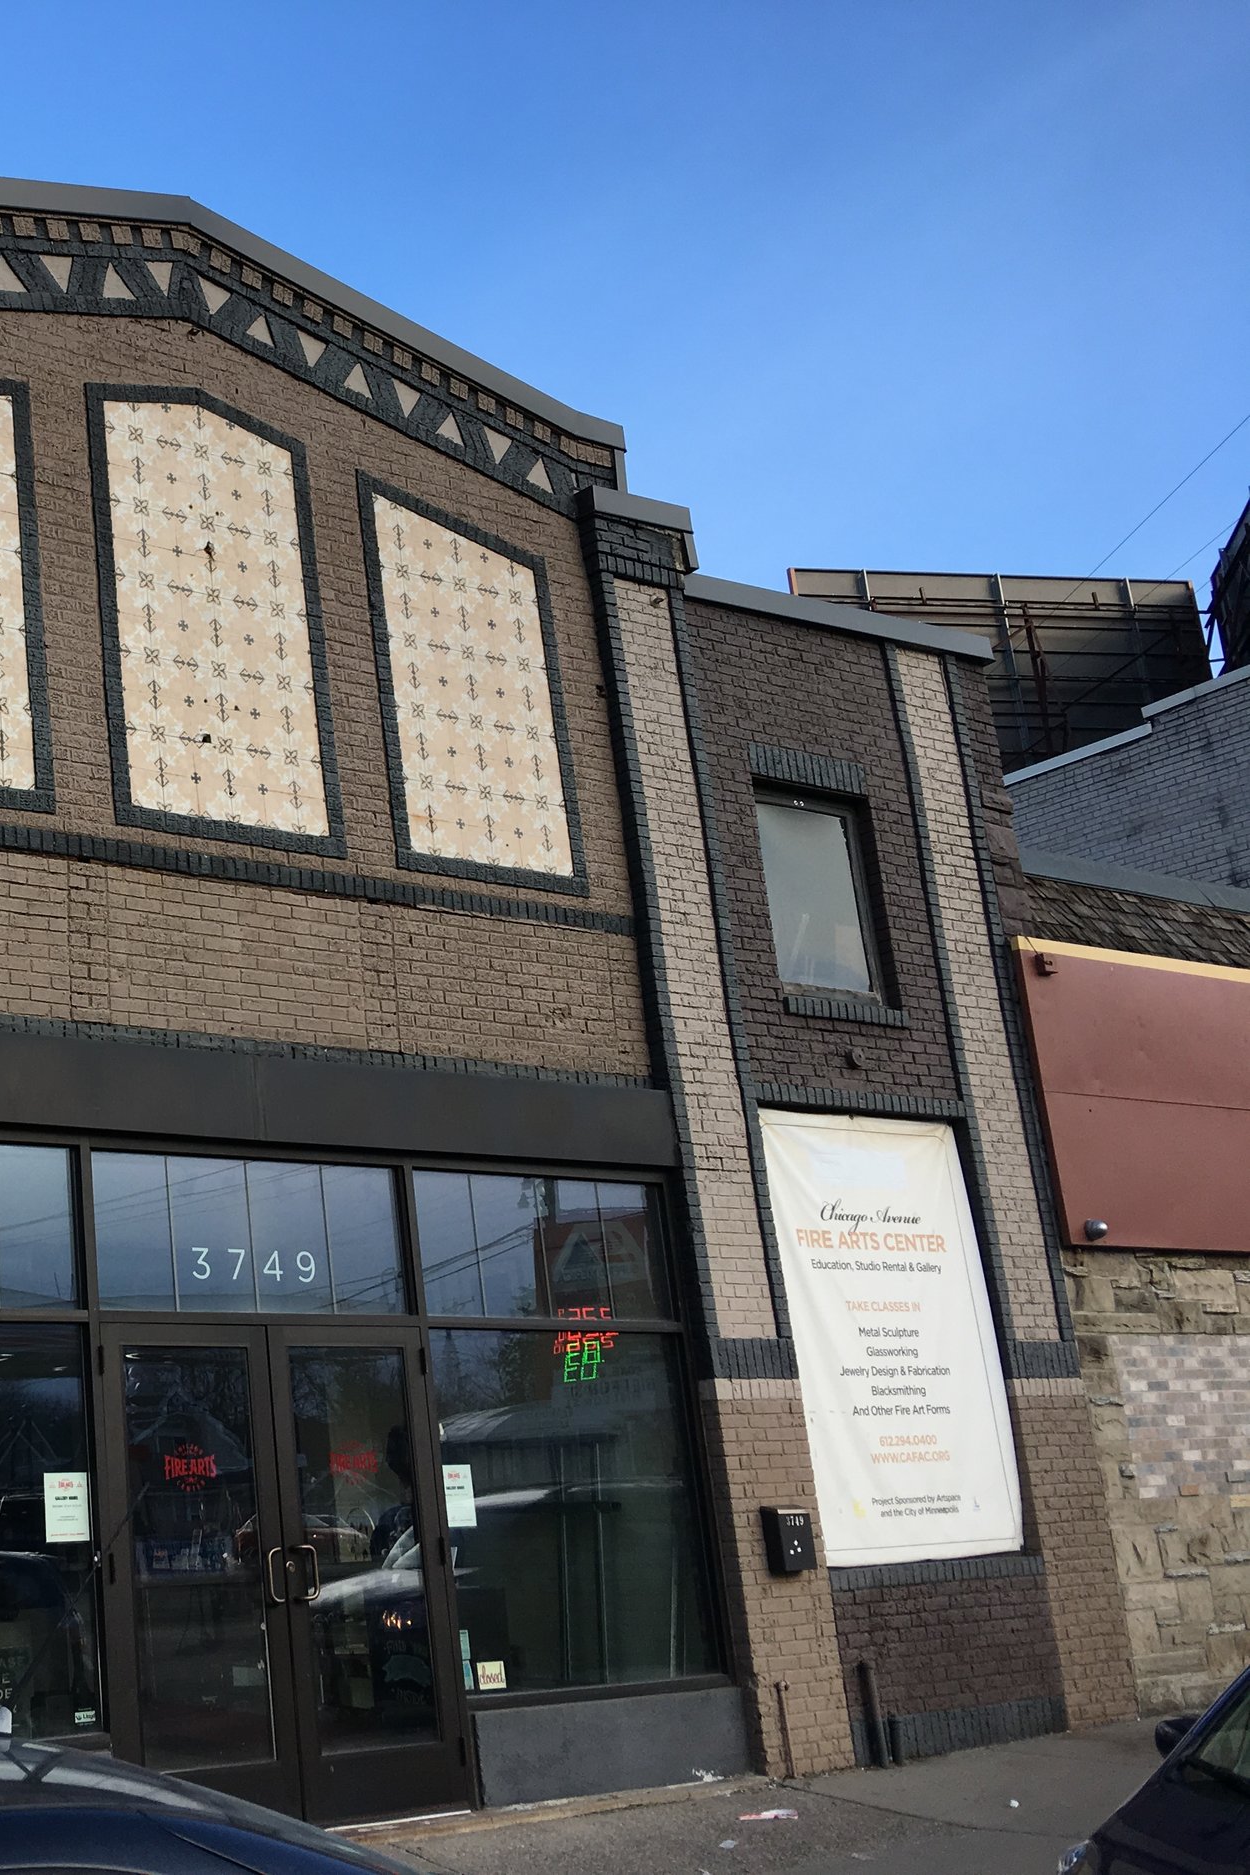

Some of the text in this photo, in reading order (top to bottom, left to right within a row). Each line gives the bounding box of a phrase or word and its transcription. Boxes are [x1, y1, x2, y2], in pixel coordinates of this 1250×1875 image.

[820, 1198, 921, 1236] Chicago Avenue
[796, 1228, 947, 1253] FIRE ARTS CENTER
[191, 1247, 316, 1283] 3749
[811, 1259, 942, 1274] Education, Studio Rental & Gallery
[846, 1300, 921, 1313] TAKE CLASSES IN
[858, 1326, 920, 1339] Metal Sculpture
[866, 1346, 919, 1358] Glassworking
[840, 1365, 951, 1378] Jewelry Design & Fabrication
[871, 1385, 926, 1397] Blacksmithing
[853, 1404, 950, 1416] And Other Fire Art Forms
[870, 1450, 950, 1464] WWW.CAFAC.ORG
[164, 1455, 217, 1480] FIRE ARTS
[871, 1494, 961, 1507] Project Sponsored by Artspace
[880, 1505, 959, 1518] and the City of Minneapolis
[479, 1664, 505, 1685] closed
